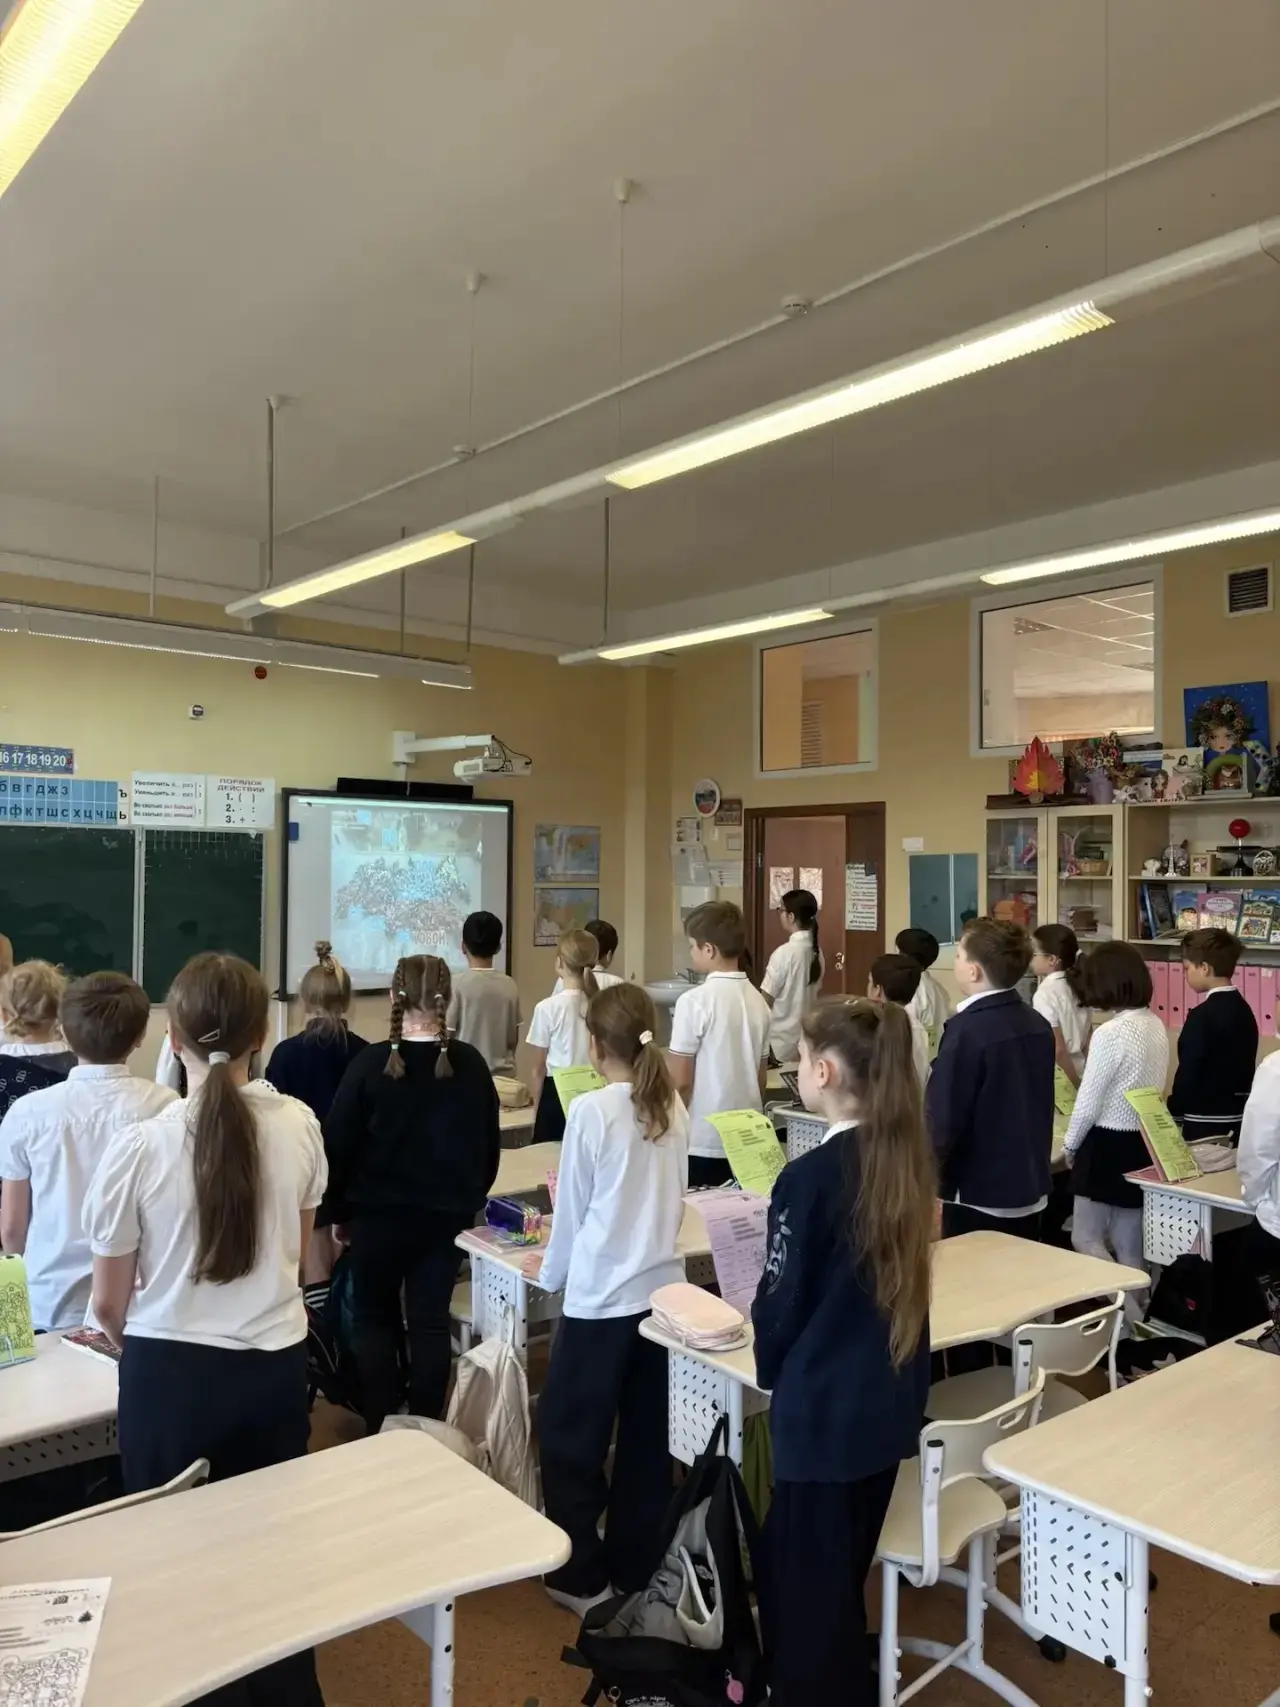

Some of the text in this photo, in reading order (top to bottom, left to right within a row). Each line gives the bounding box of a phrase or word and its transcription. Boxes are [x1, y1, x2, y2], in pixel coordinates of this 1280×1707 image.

[12, 752, 23, 764] 17
[26, 753, 37, 765] 18
[40, 754, 51, 766] 19
[53, 755, 66, 767] 20
[226, 792, 233, 801] 1.
[9, 804, 22, 818] ф
[225, 804, 235, 812] 2.
[225, 815, 236, 823] 3.
